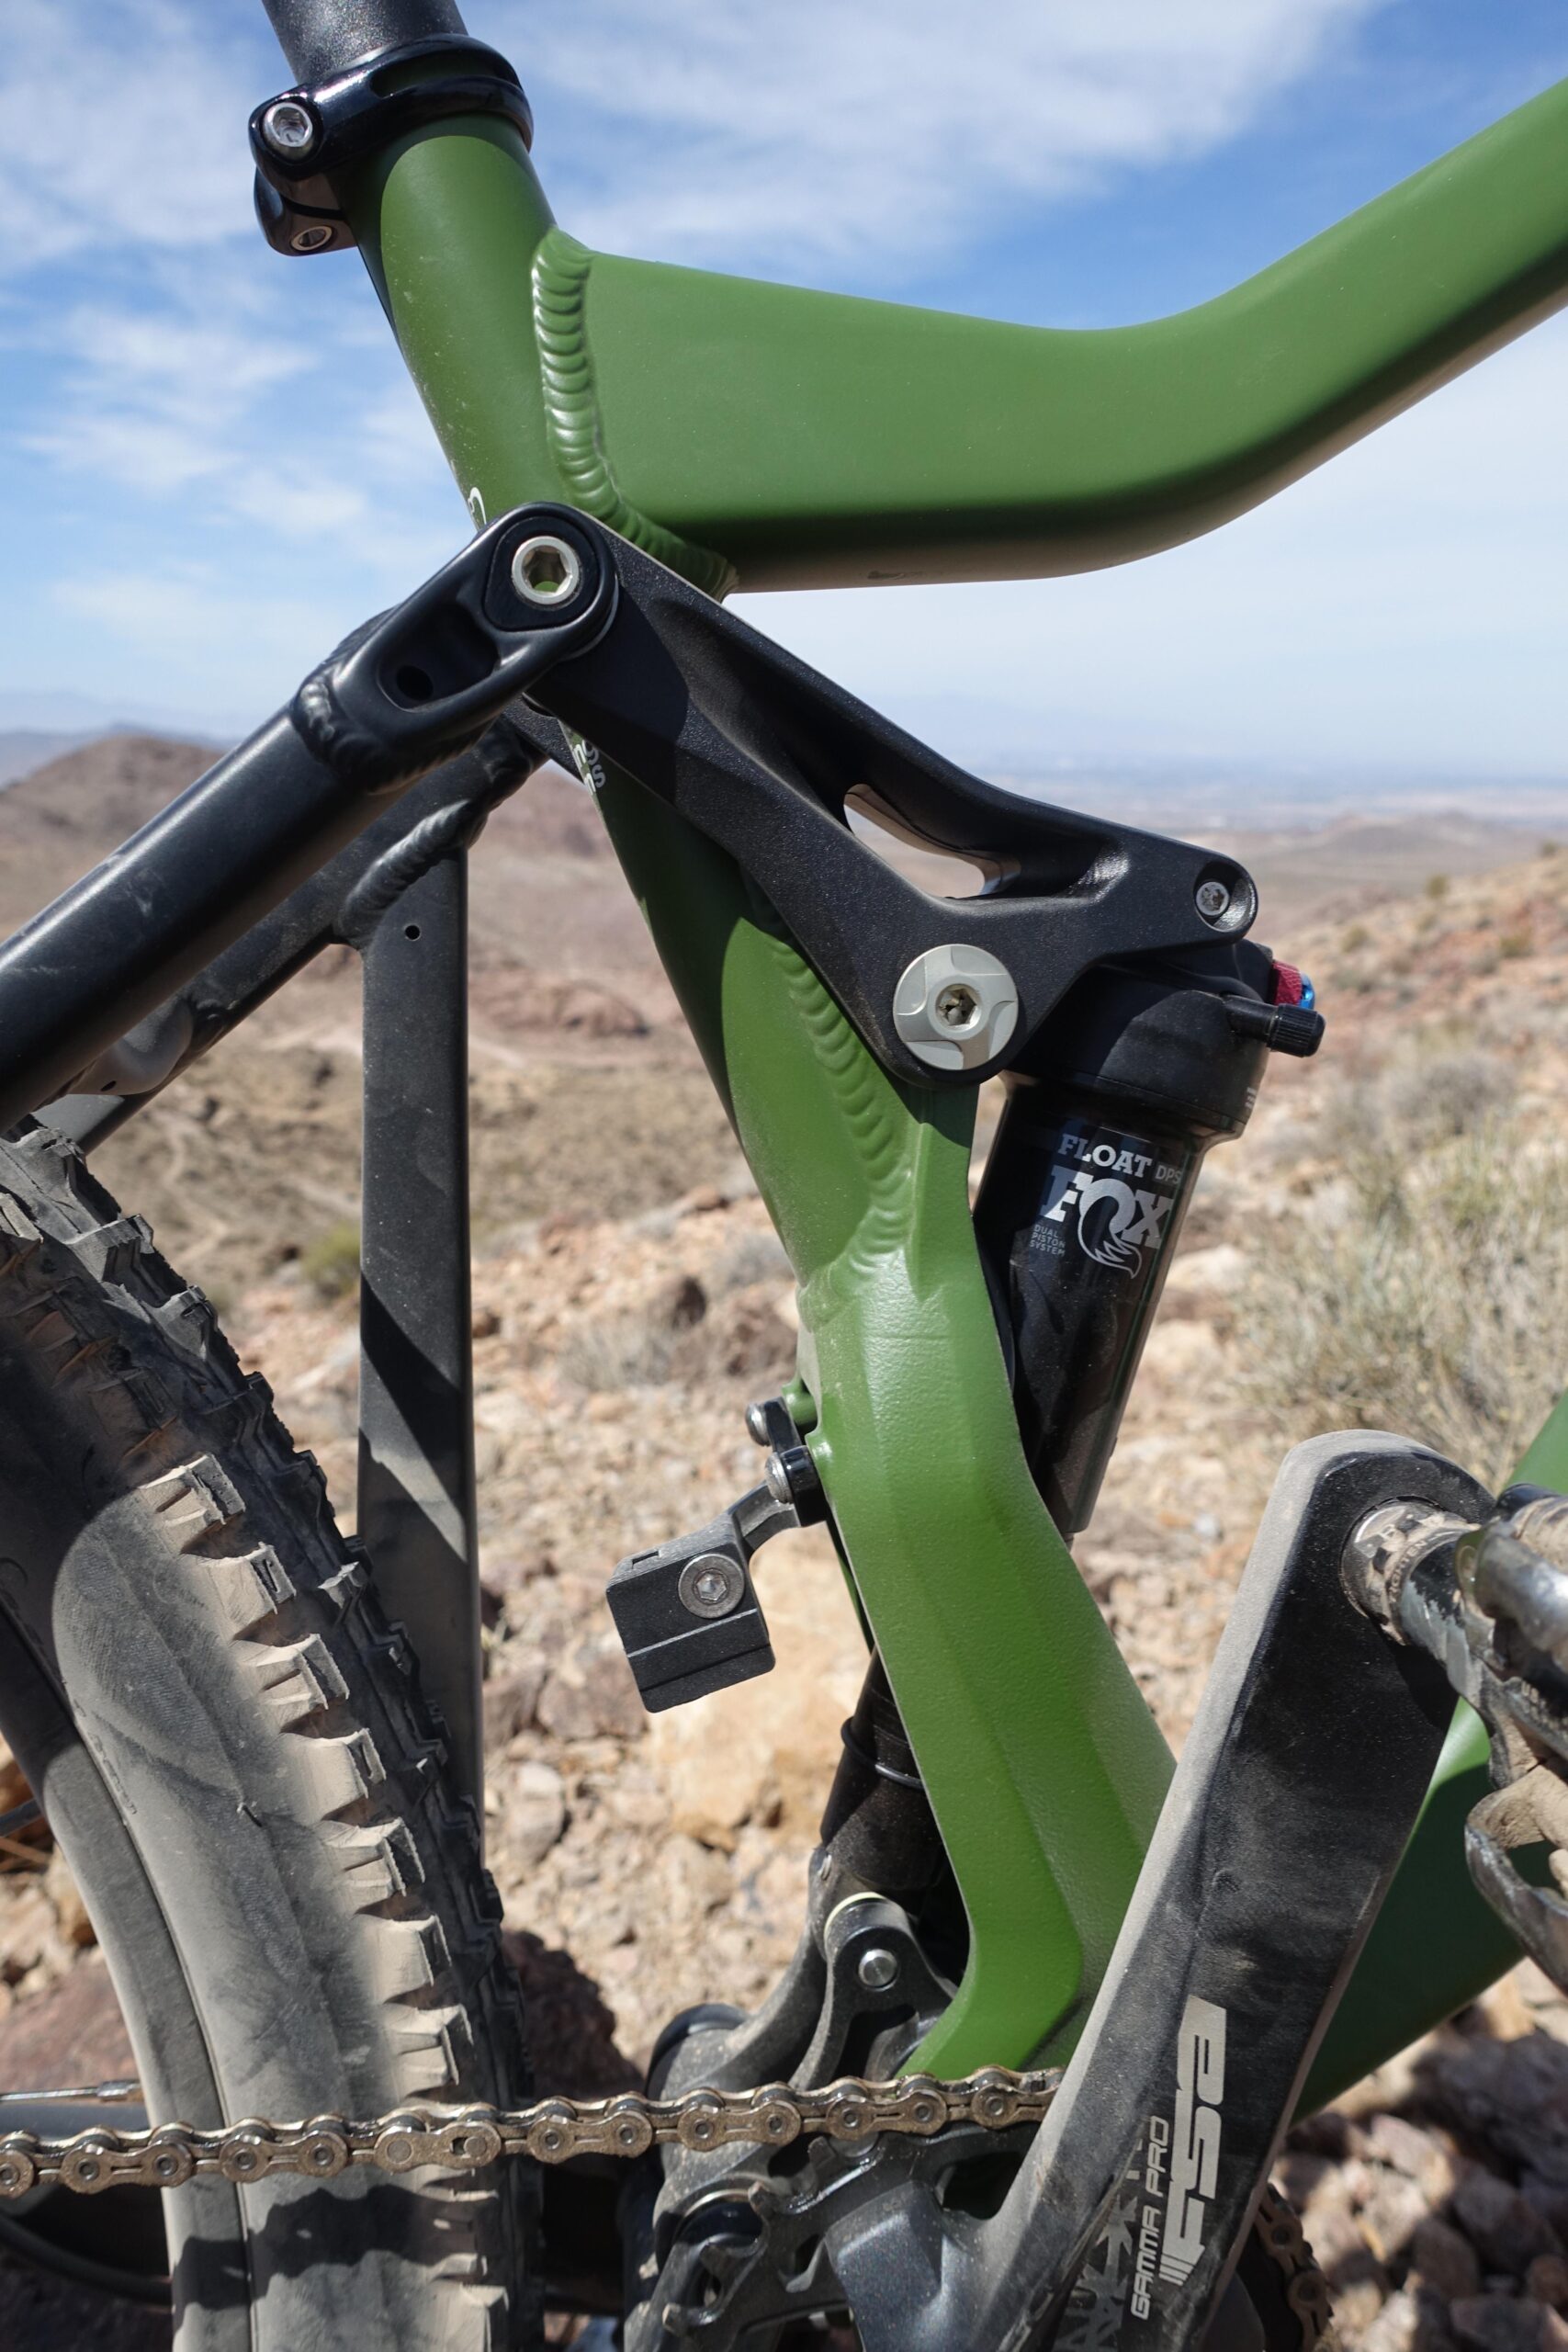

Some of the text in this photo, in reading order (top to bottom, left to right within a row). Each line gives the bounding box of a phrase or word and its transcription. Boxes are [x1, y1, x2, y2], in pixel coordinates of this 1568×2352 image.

[1058, 1133, 1182, 1184] FLOAT DPS
[1034, 1224, 1058, 1238] DUAL
[1039, 1164, 1174, 1279] FOX
[1029, 1240, 1066, 1257] SYSTEM
[1032, 1232, 1066, 1247] PISTON
[1131, 2115, 1169, 2320] GAMMA PRO
